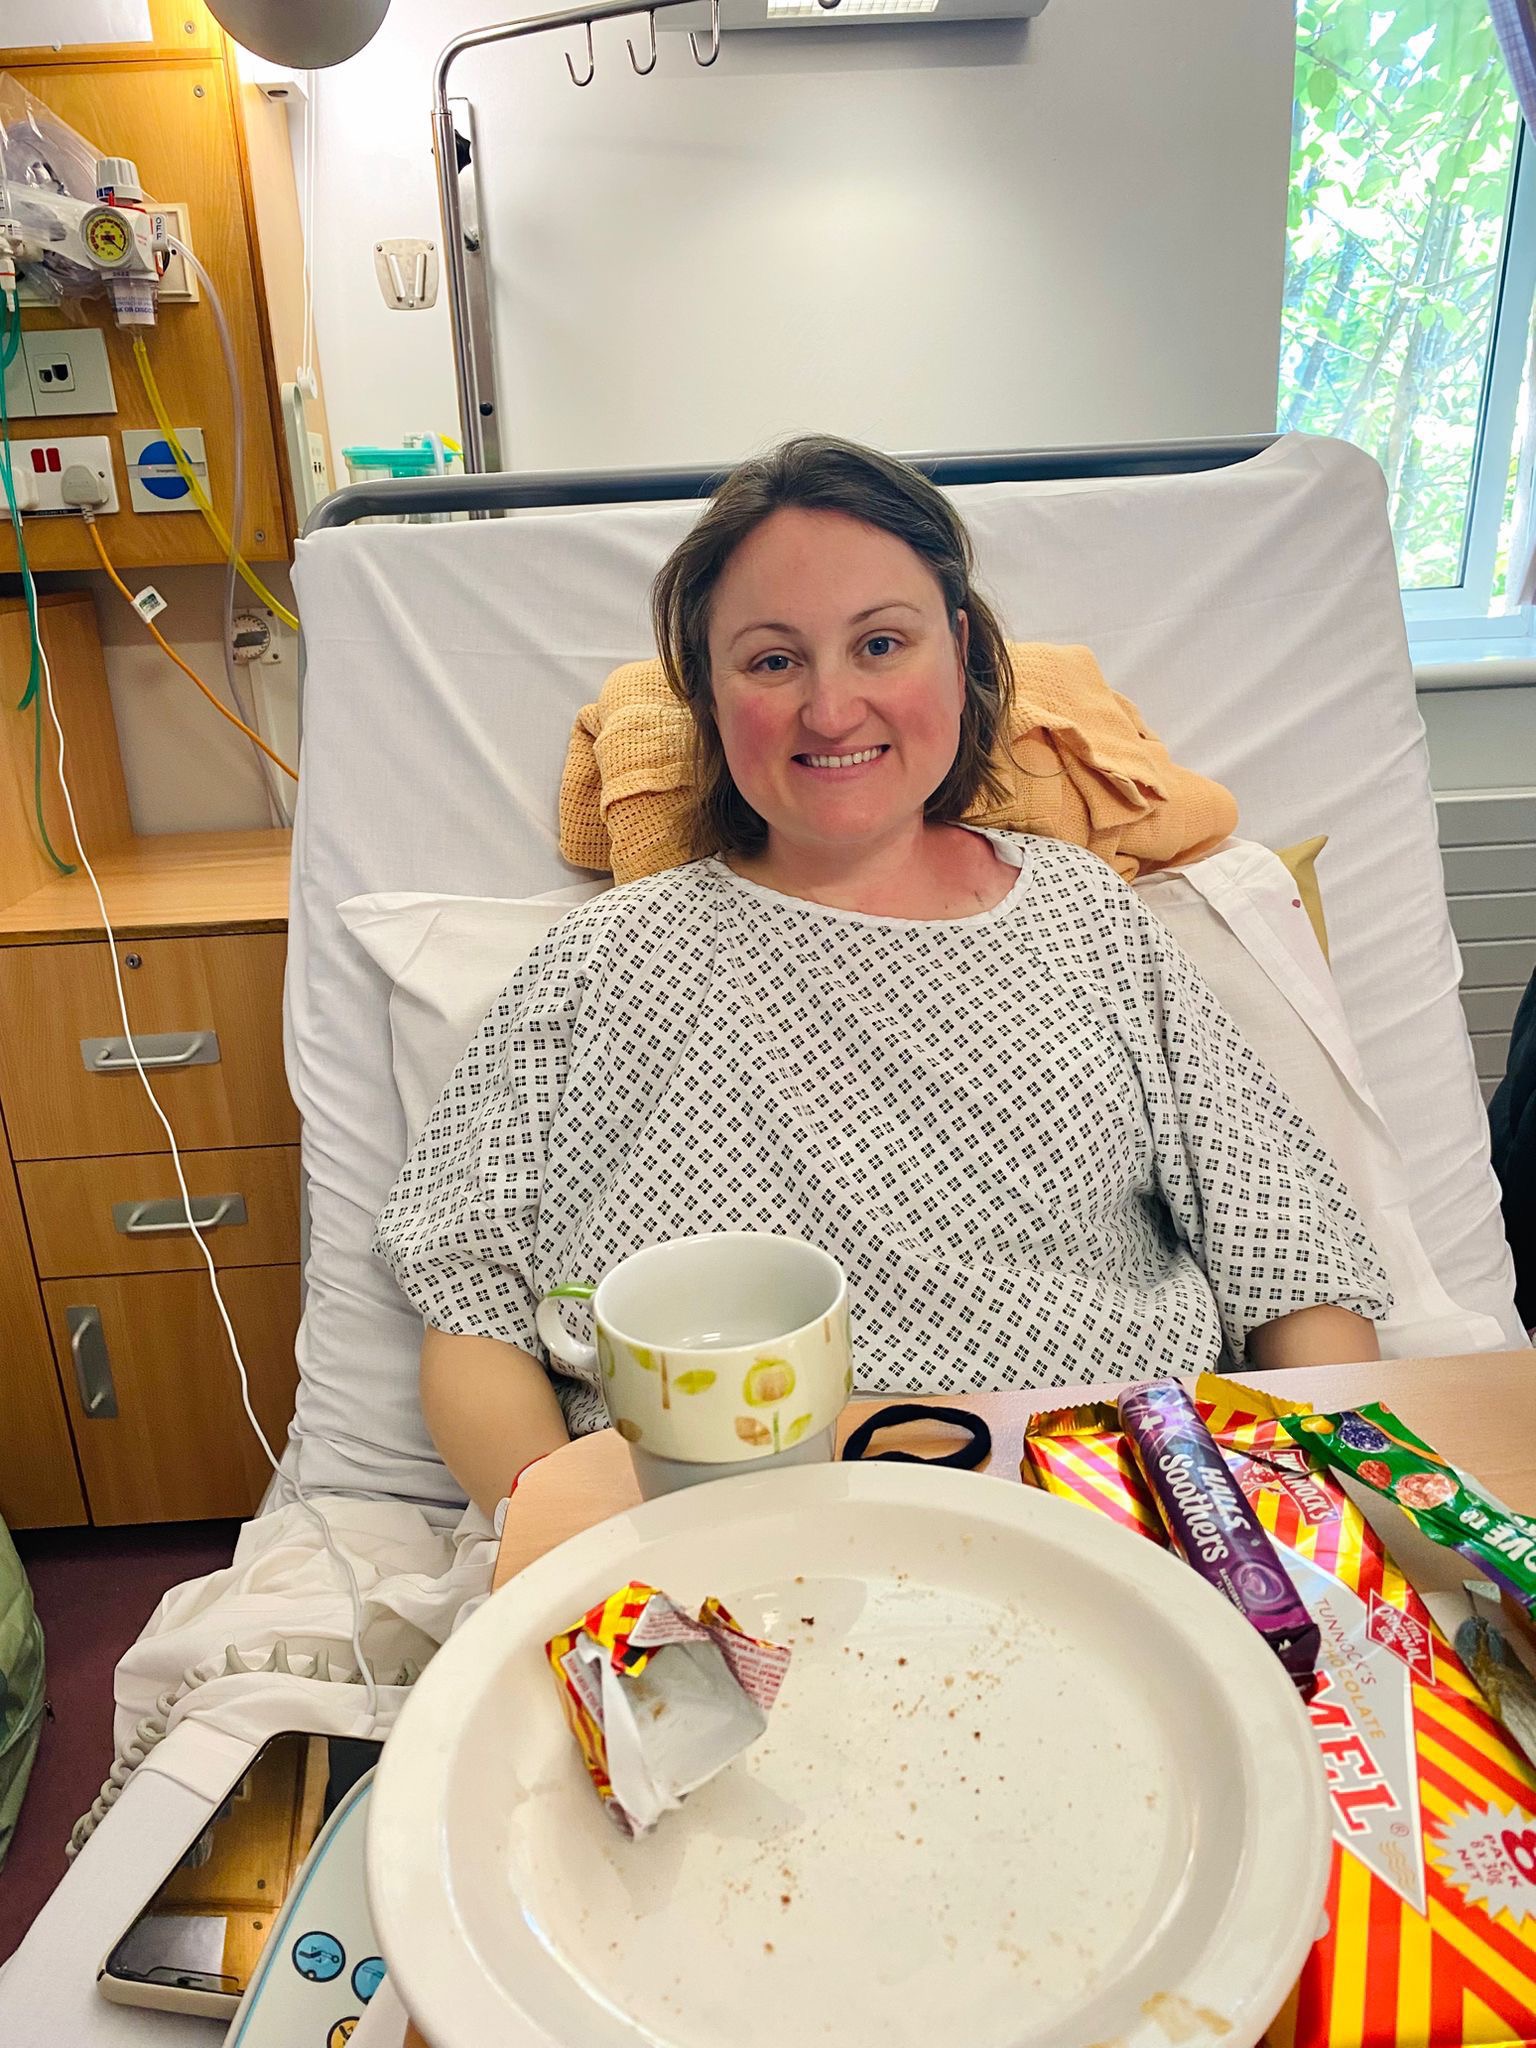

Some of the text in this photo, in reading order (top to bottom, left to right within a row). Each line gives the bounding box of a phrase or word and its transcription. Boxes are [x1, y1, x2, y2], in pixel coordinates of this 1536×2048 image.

[1159, 1454, 1229, 1563] Soothers
[1197, 1466, 1251, 1532] HALLS
[1315, 1598, 1377, 1685] TUNNOCK'S
[1375, 1604, 1427, 1665] ORIGINAL
[1403, 1620, 1426, 1645] STILL
[1322, 1638, 1386, 1739] CHOCOLATE
[1457, 1849, 1483, 1882] NET
[1483, 1834, 1522, 1888] PACK
